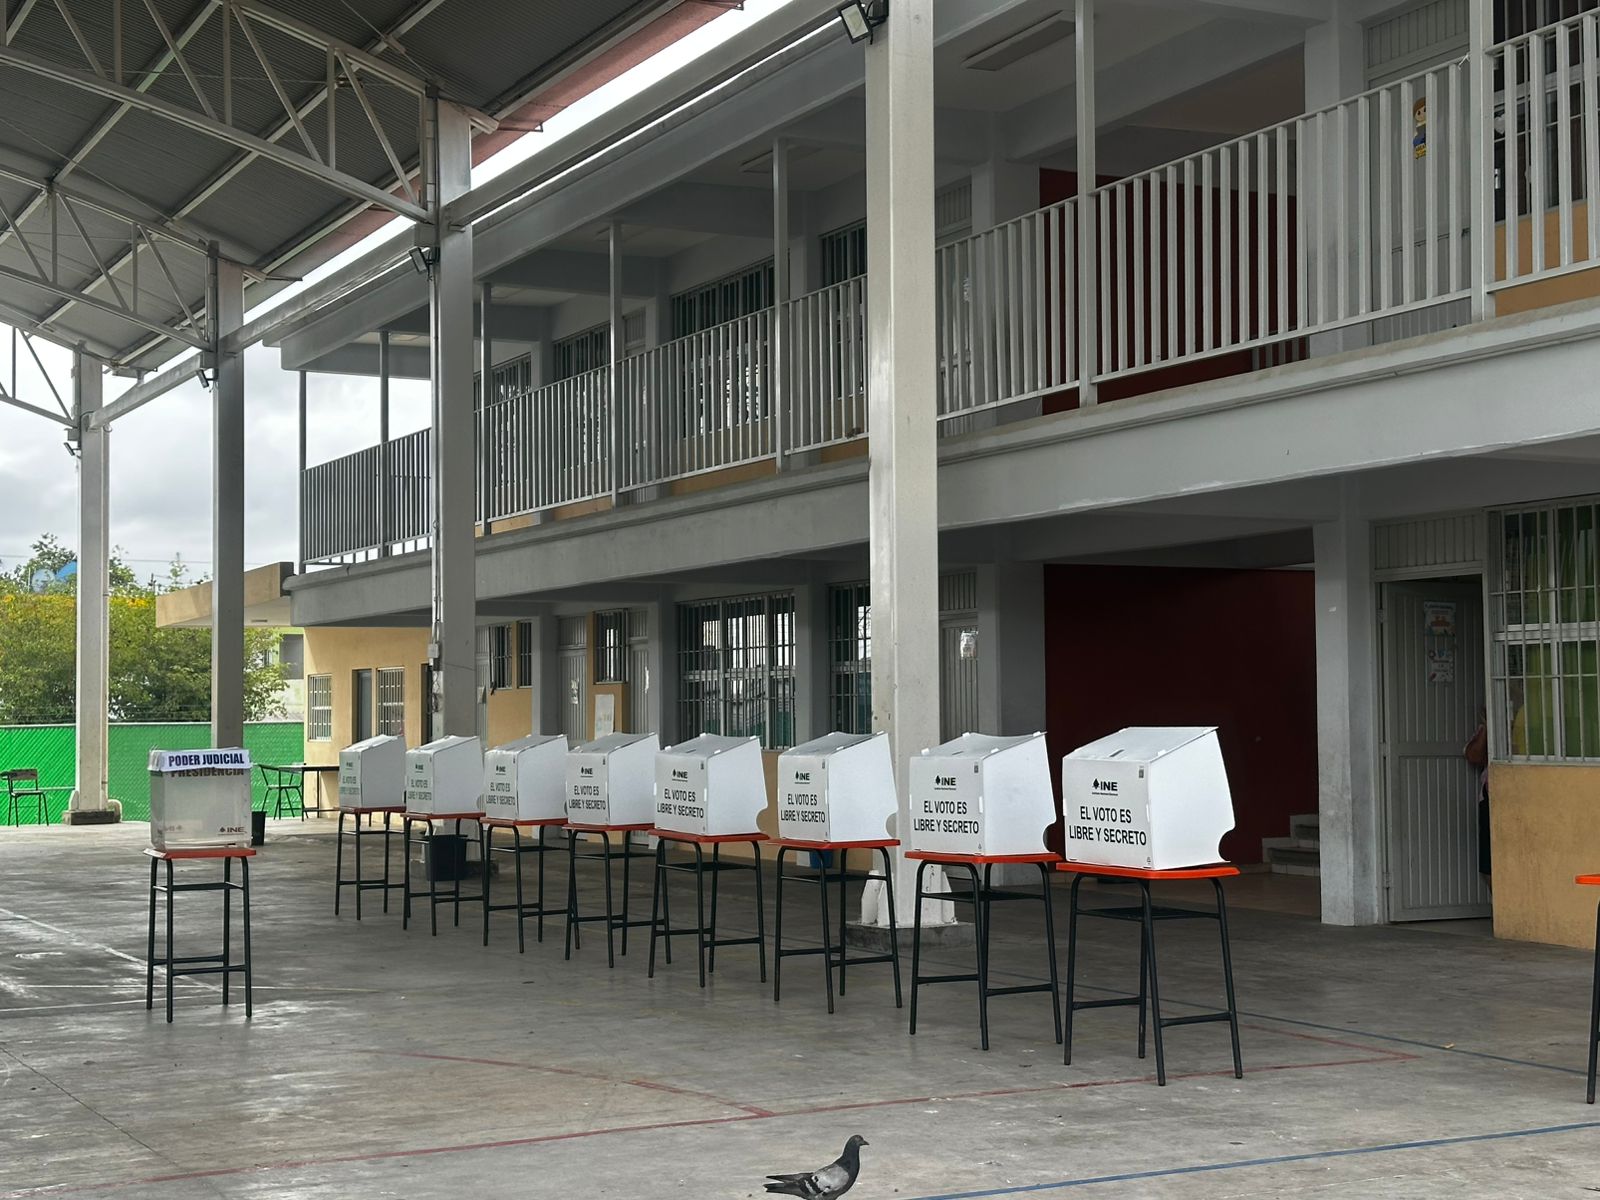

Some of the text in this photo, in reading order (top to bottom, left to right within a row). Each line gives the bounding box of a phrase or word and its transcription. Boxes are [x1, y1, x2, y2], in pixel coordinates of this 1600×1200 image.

[168, 753, 244, 767] PODER JUDICIAL
[677, 771, 688, 779] INE
[799, 773, 810, 781] INE
[941, 777, 957, 786] INE
[1100, 781, 1118, 791] INE
[664, 788, 696, 802] EL VOTO ES
[787, 793, 818, 806] EL VOTO ES
[657, 803, 704, 818] LIBRE Y SECRETO
[924, 800, 968, 815] EL VOTO ES
[1080, 806, 1132, 823] EL VOTO ES
[780, 810, 826, 823] LIBRE Y SECRETO
[913, 818, 980, 834] LIBRE Y SECRETO
[1069, 825, 1147, 846] LIBRE Y SECRETO
